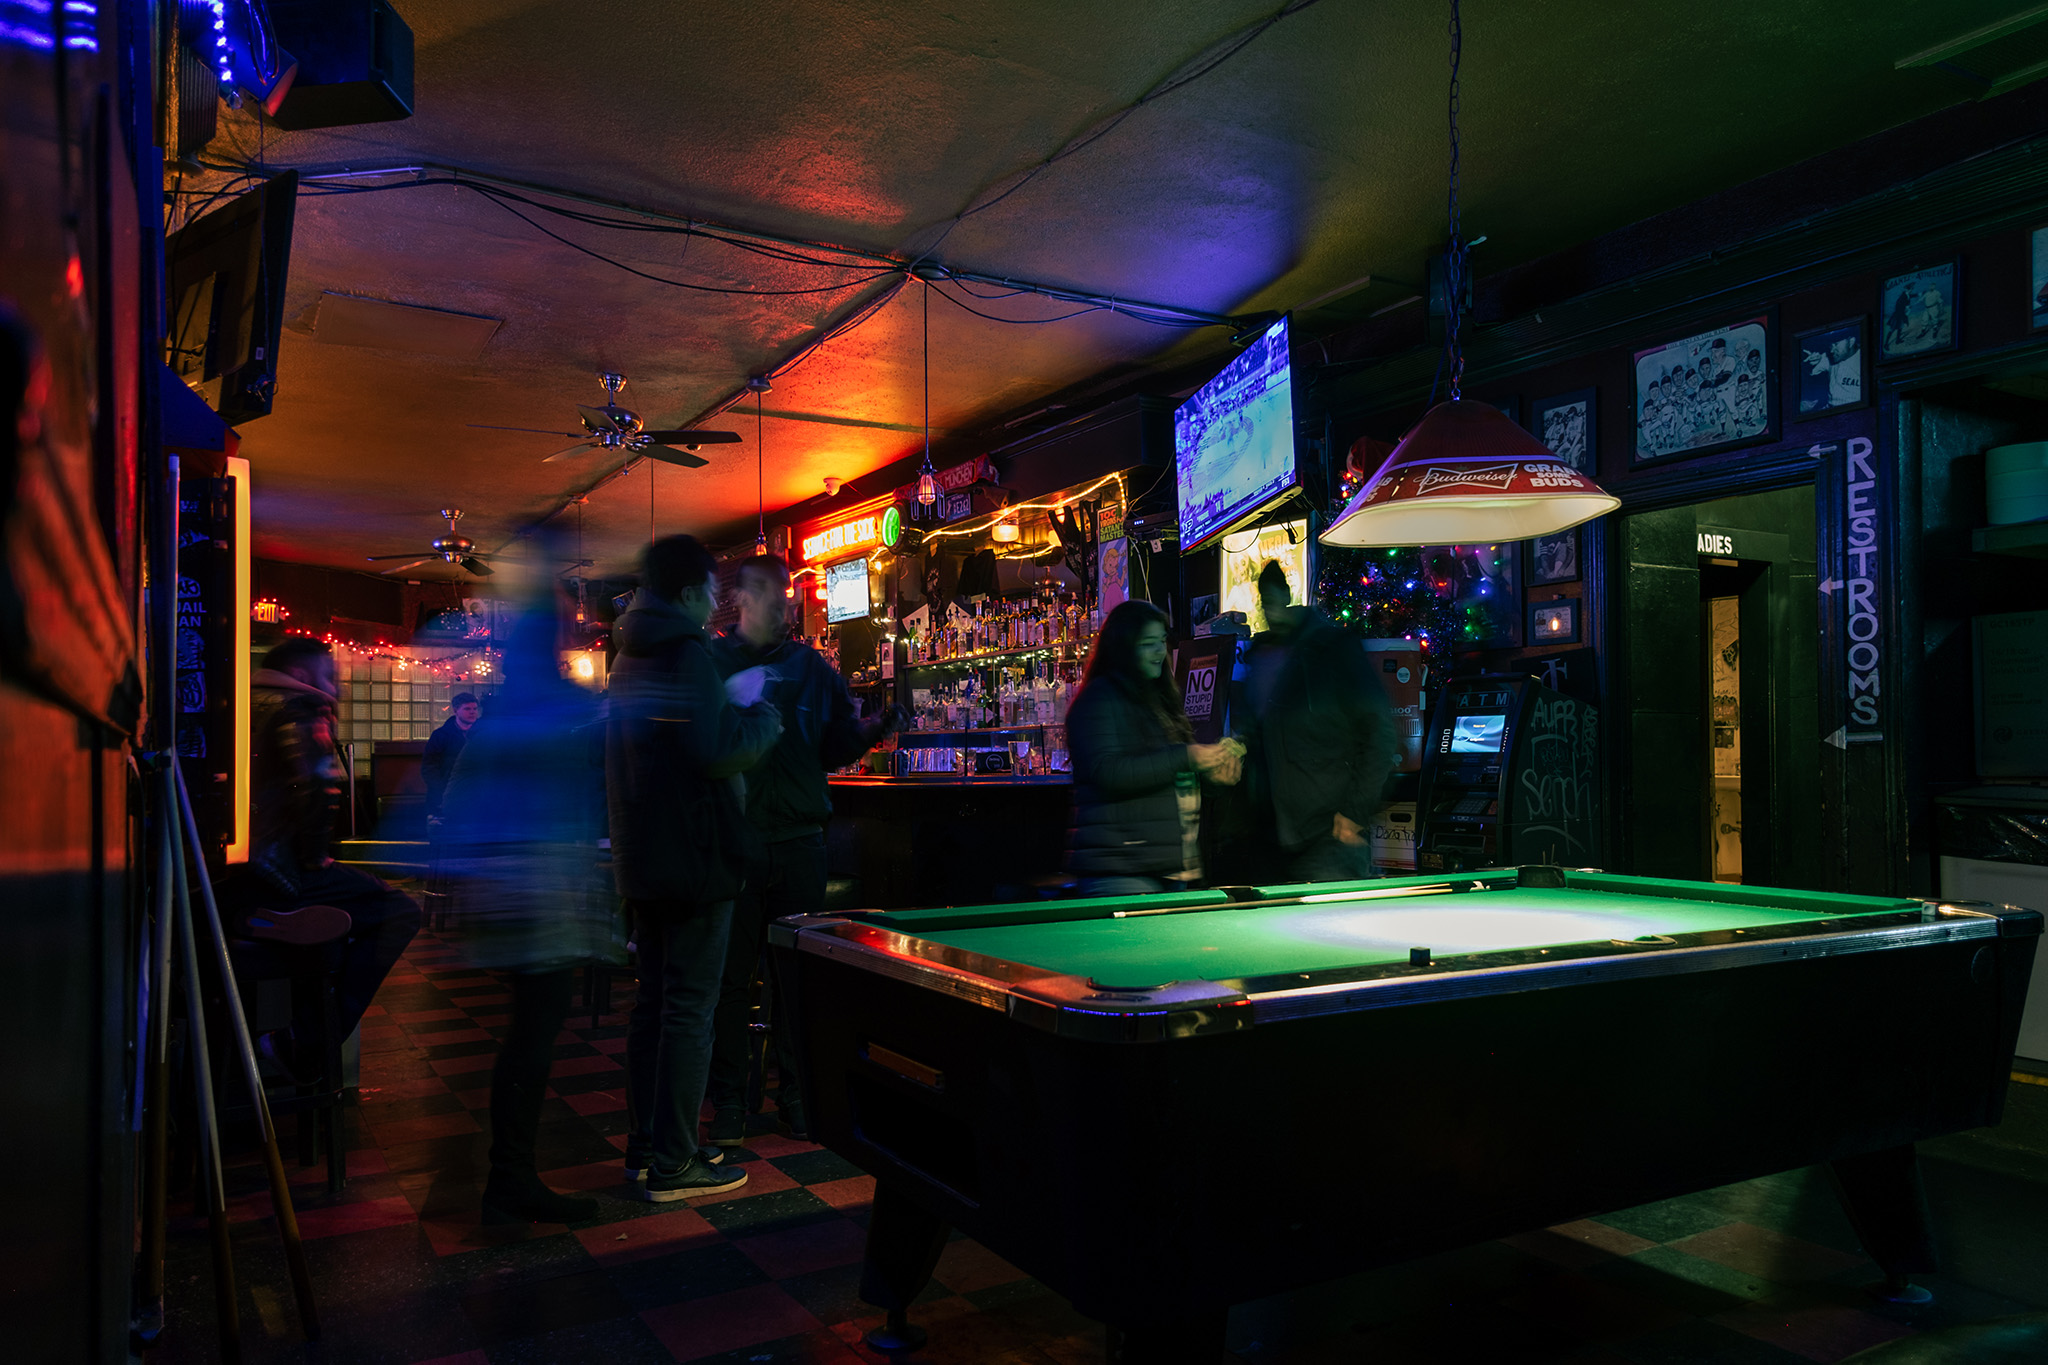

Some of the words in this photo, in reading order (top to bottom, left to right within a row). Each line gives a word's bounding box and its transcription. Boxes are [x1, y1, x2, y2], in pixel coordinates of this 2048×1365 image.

[1523, 463, 1577, 476] GRAB
[1536, 471, 1573, 480] SOME
[1413, 470, 1518, 487] Budweiser
[1529, 477, 1585, 488] BUDS
[1697, 533, 1733, 554] ADIES
[1846, 436, 1880, 725] RESTROOMS
[258, 602, 276, 622] EXIT
[1187, 669, 1215, 694] NO
[1185, 693, 1212, 705] STUPID
[1459, 692, 1508, 707] ATM
[1184, 703, 1211, 715] PEOPLE
